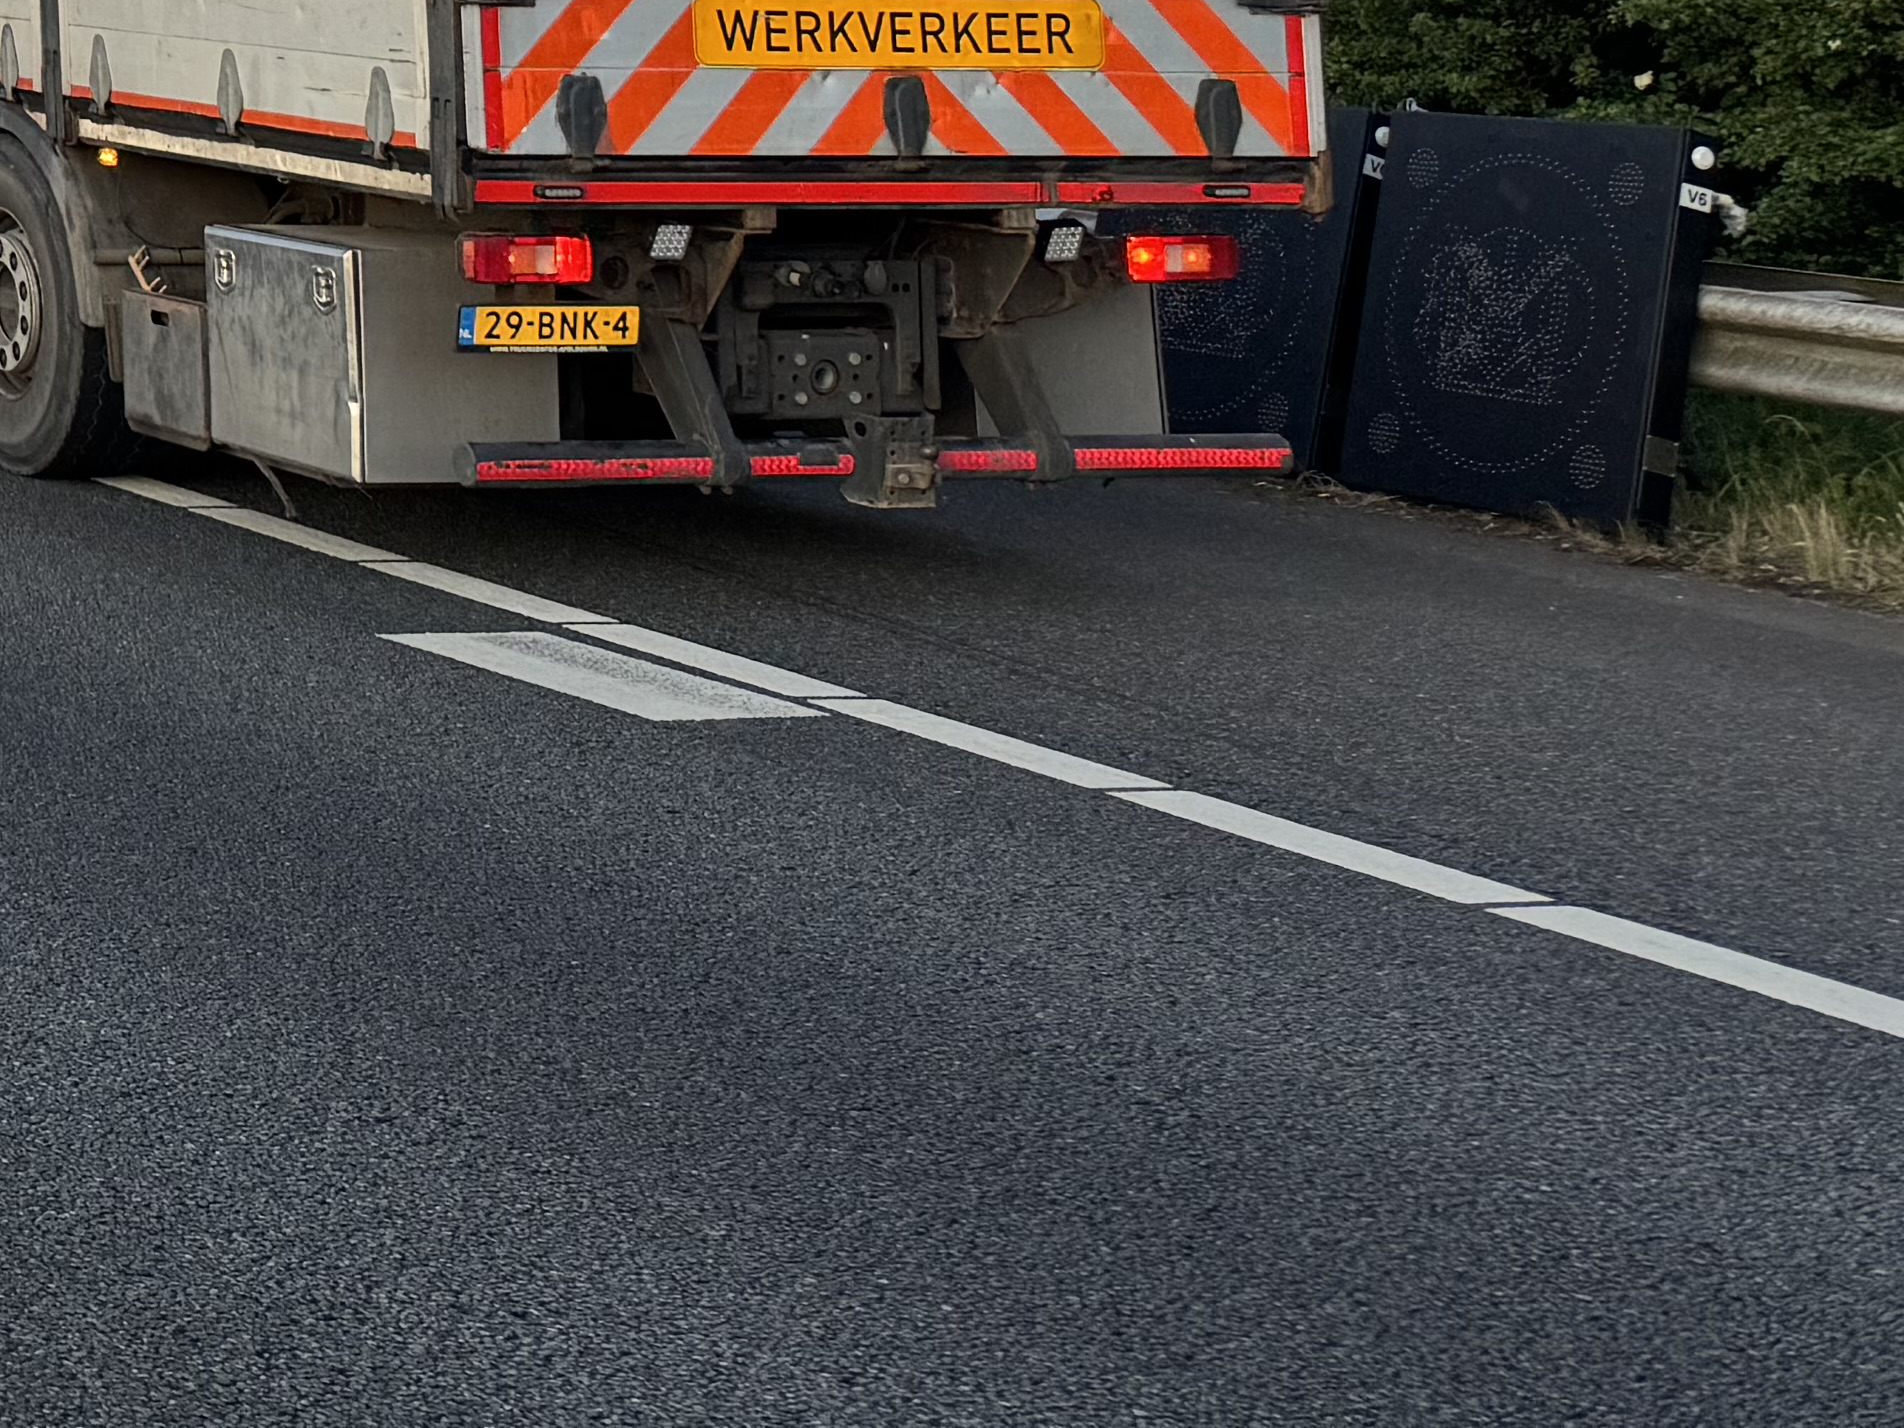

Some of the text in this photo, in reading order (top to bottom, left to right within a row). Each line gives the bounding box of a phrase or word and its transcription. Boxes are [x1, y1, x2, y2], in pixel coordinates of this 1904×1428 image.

[715, 9, 1074, 55] WERKVERKEER
[1688, 188, 1708, 207] V6
[484, 310, 630, 341] 29-BNK-4
